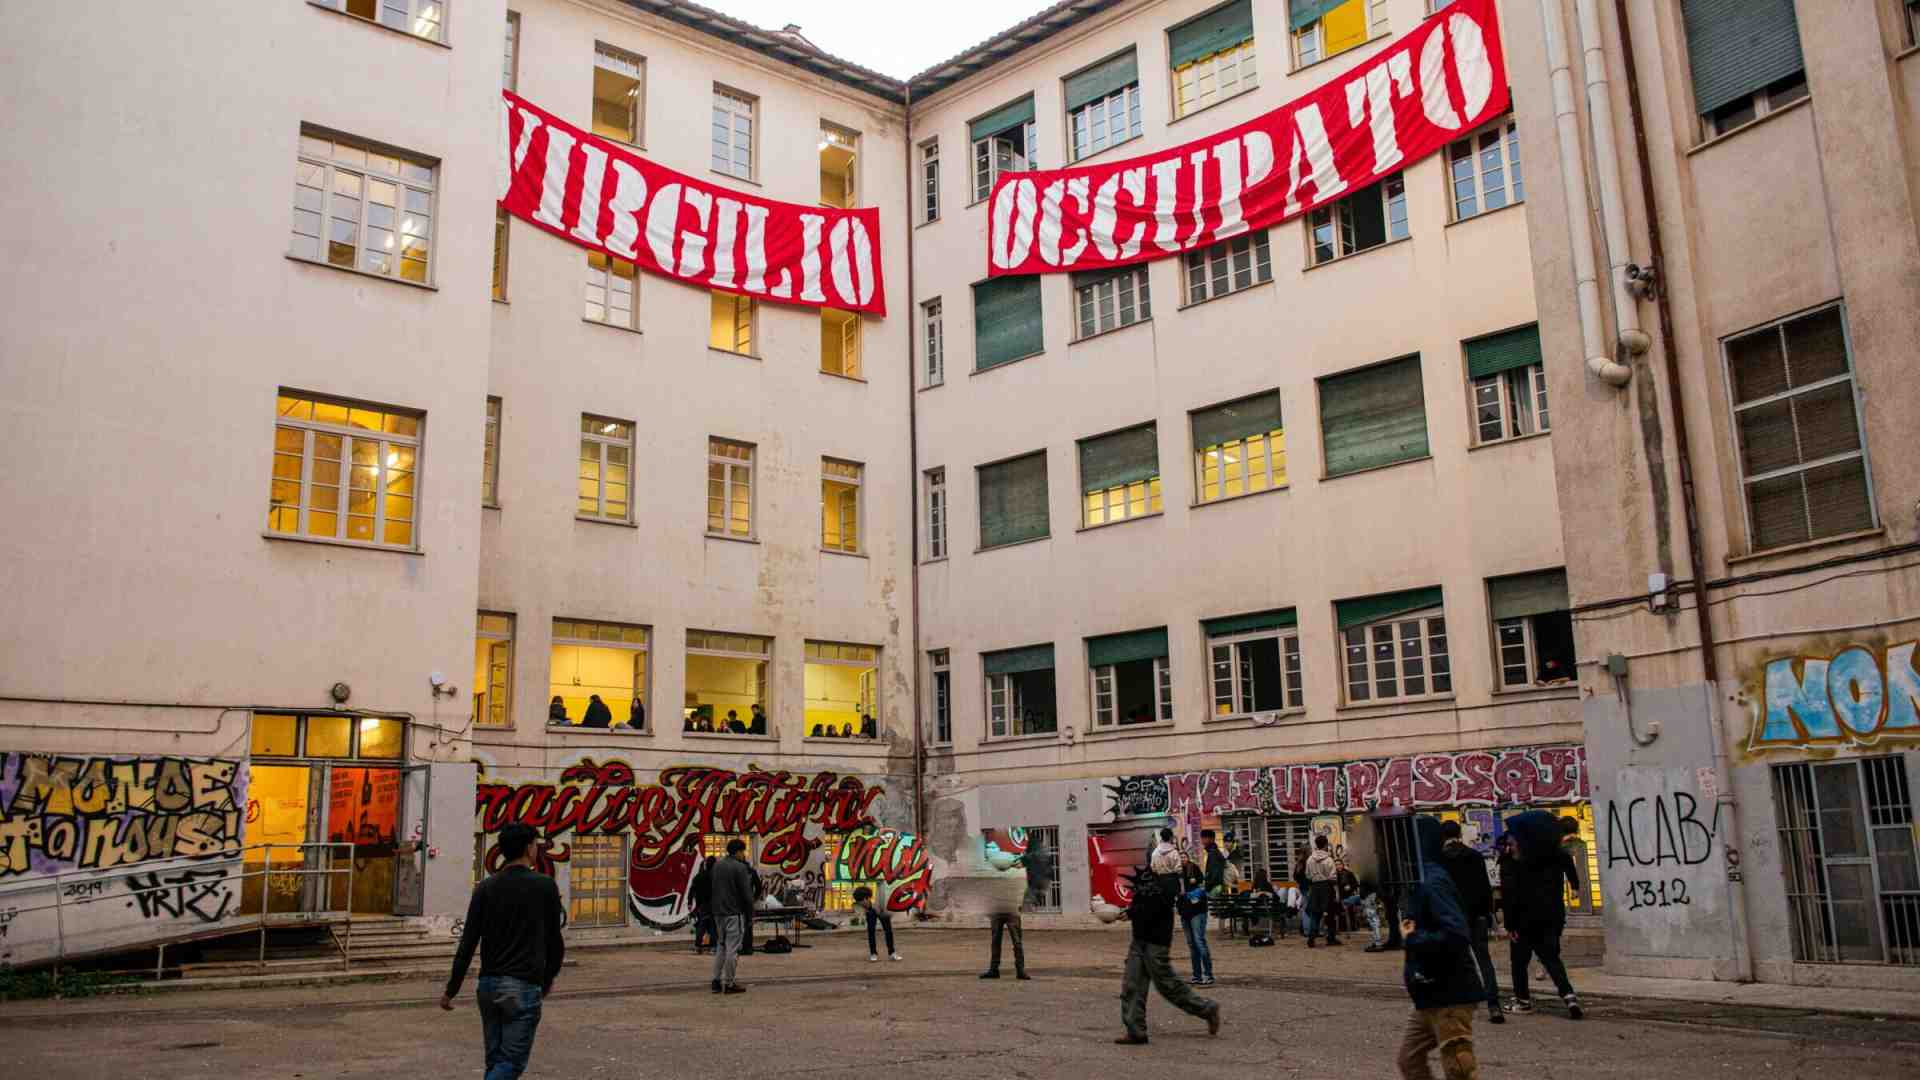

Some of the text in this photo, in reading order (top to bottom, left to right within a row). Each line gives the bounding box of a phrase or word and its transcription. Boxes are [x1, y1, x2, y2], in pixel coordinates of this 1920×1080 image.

[497, 97, 875, 306] VIRGILIO
[991, 12, 1493, 269] OCCUPATO
[1164, 769, 1258, 818] MAI
[1270, 764, 1338, 813] UN
[1342, 750, 1535, 808] PASSO
[1626, 878, 1691, 911] 1312
